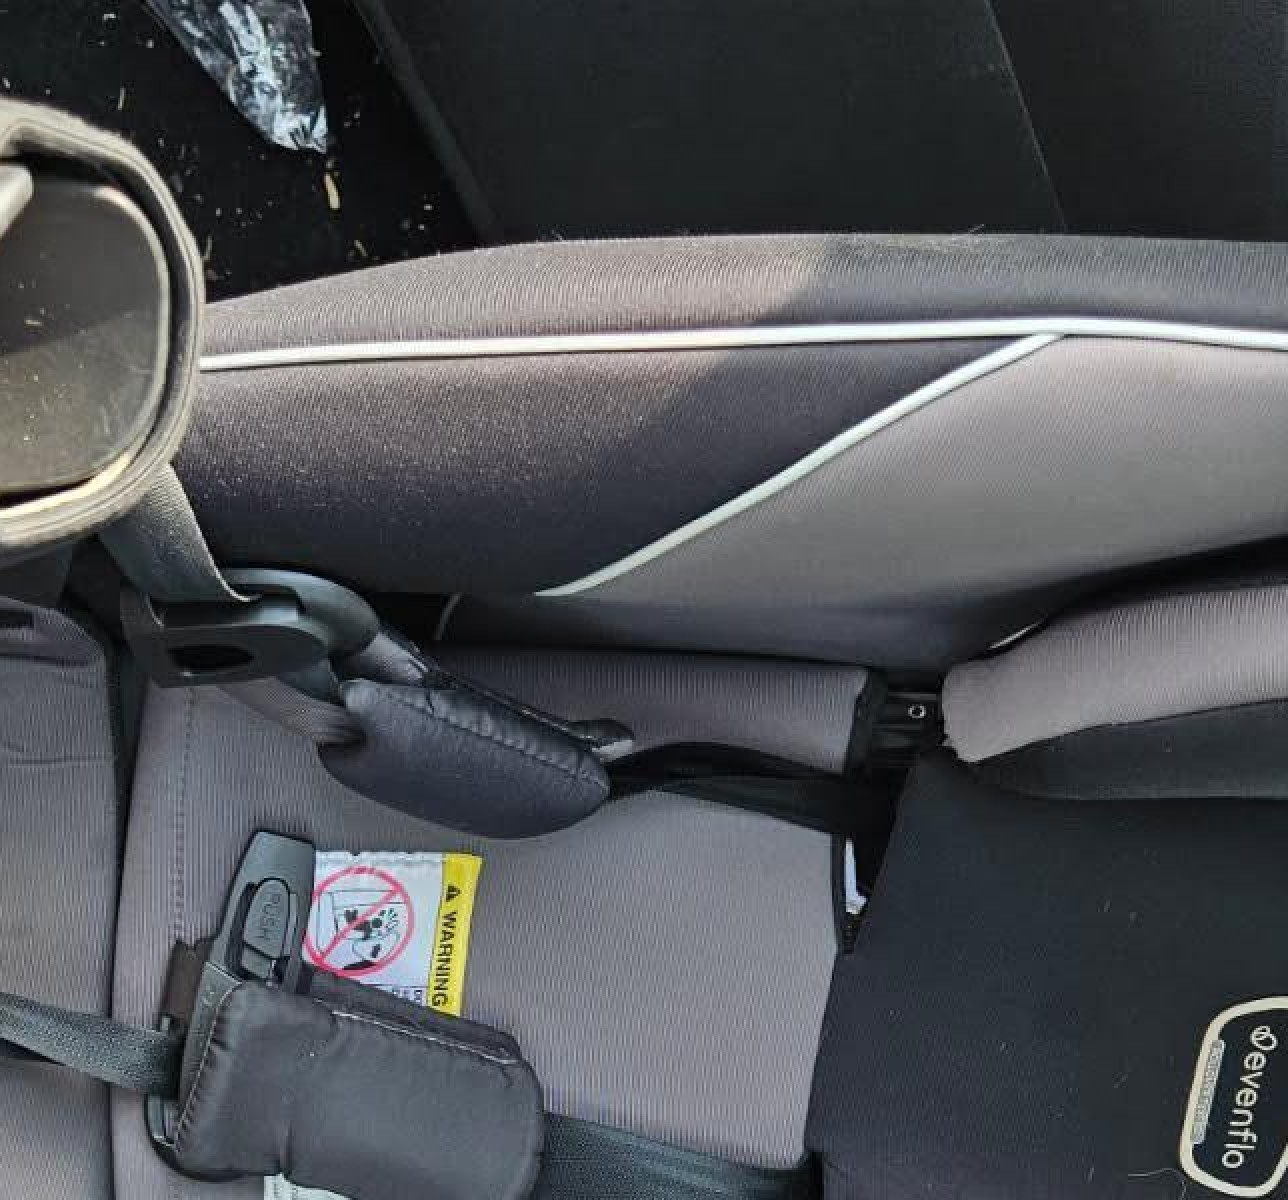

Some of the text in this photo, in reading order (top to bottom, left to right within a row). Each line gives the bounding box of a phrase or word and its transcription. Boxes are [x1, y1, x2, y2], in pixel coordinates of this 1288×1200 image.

[255, 893, 282, 940] PUSH
[431, 911, 458, 1007] WARNING
[1221, 1051, 1267, 1169] evenflo
